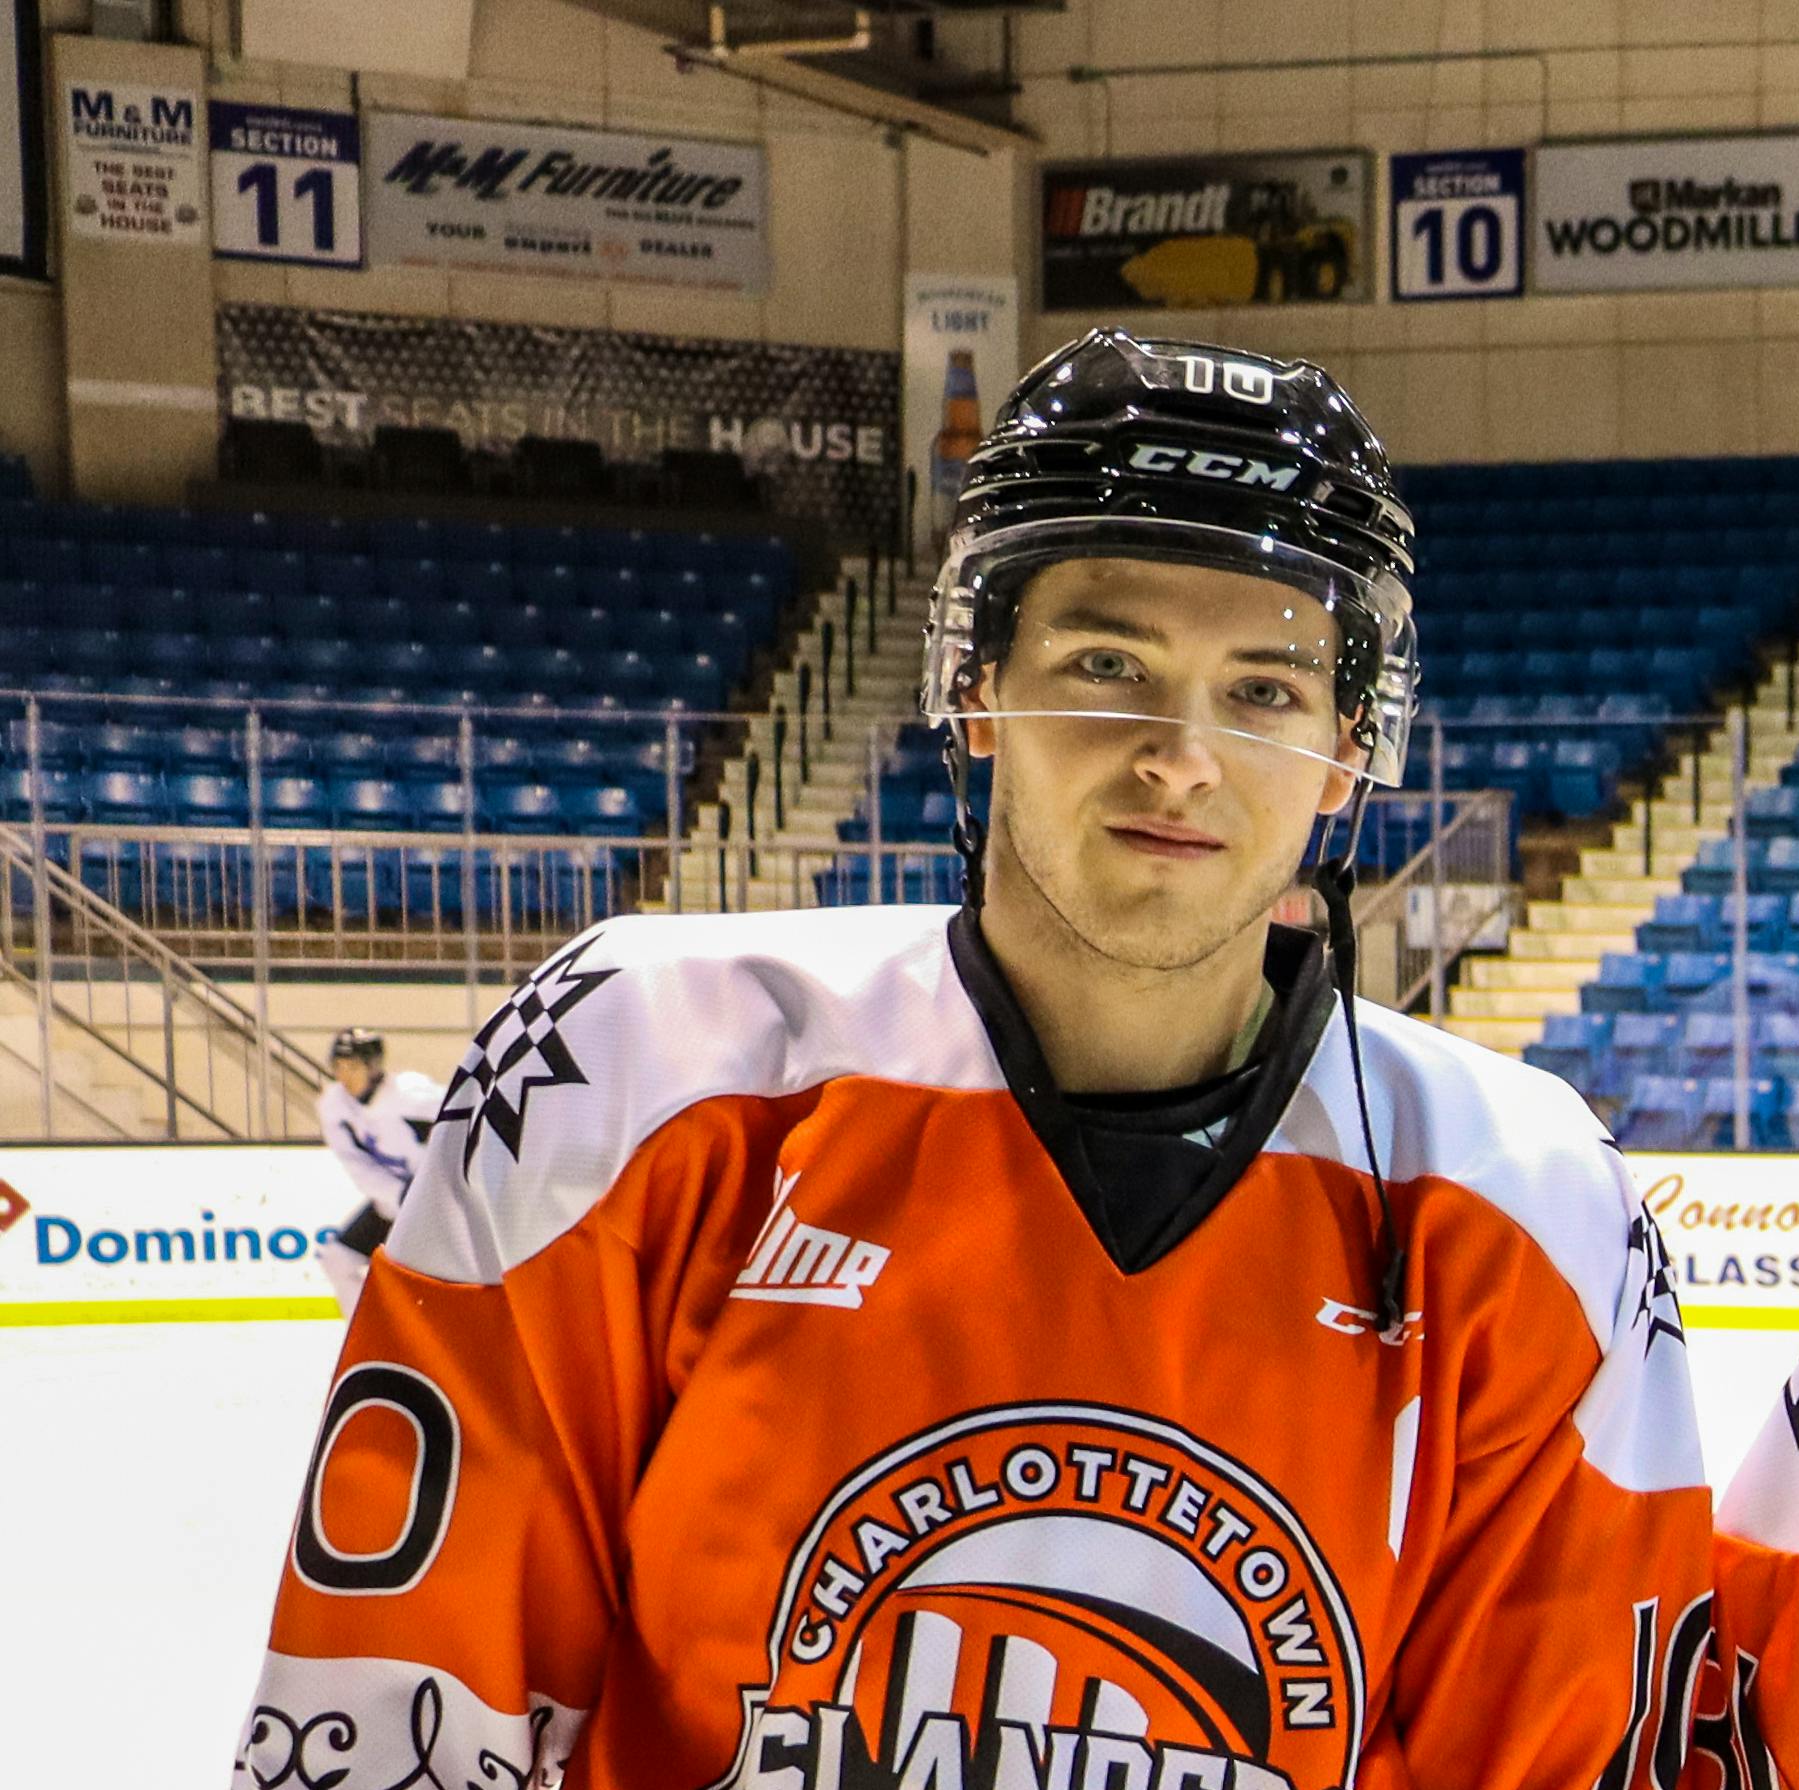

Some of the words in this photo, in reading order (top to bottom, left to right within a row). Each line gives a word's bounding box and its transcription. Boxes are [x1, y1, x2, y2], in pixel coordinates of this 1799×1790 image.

[72, 88, 113, 121] M
[152, 97, 192, 128] M
[73, 121, 192, 145] FURNITURE
[230, 128, 338, 157] SECTION
[95, 161, 124, 177] THE
[131, 164, 174, 181] BEST
[102, 180, 168, 198] SEATS
[384, 141, 529, 201] M&M
[519, 147, 742, 209] Furniture
[1414, 174, 1499, 197] SECTION
[101, 212, 173, 234] HOUSE
[238, 163, 334, 250] 11
[1080, 183, 1230, 235] Brandt
[427, 222, 487, 239] YOUR
[639, 238, 713, 258] DEALER
[1413, 206, 1502, 284] 10
[1174, 355, 1274, 404] 10
[232, 384, 368, 431] BEST
[547, 408, 596, 445] IN
[612, 414, 700, 453] THE
[709, 416, 885, 465] HOUSE
[1128, 443, 1302, 493] CCM
[798, 1445, 1334, 1728] CHARLOTTETOWN
